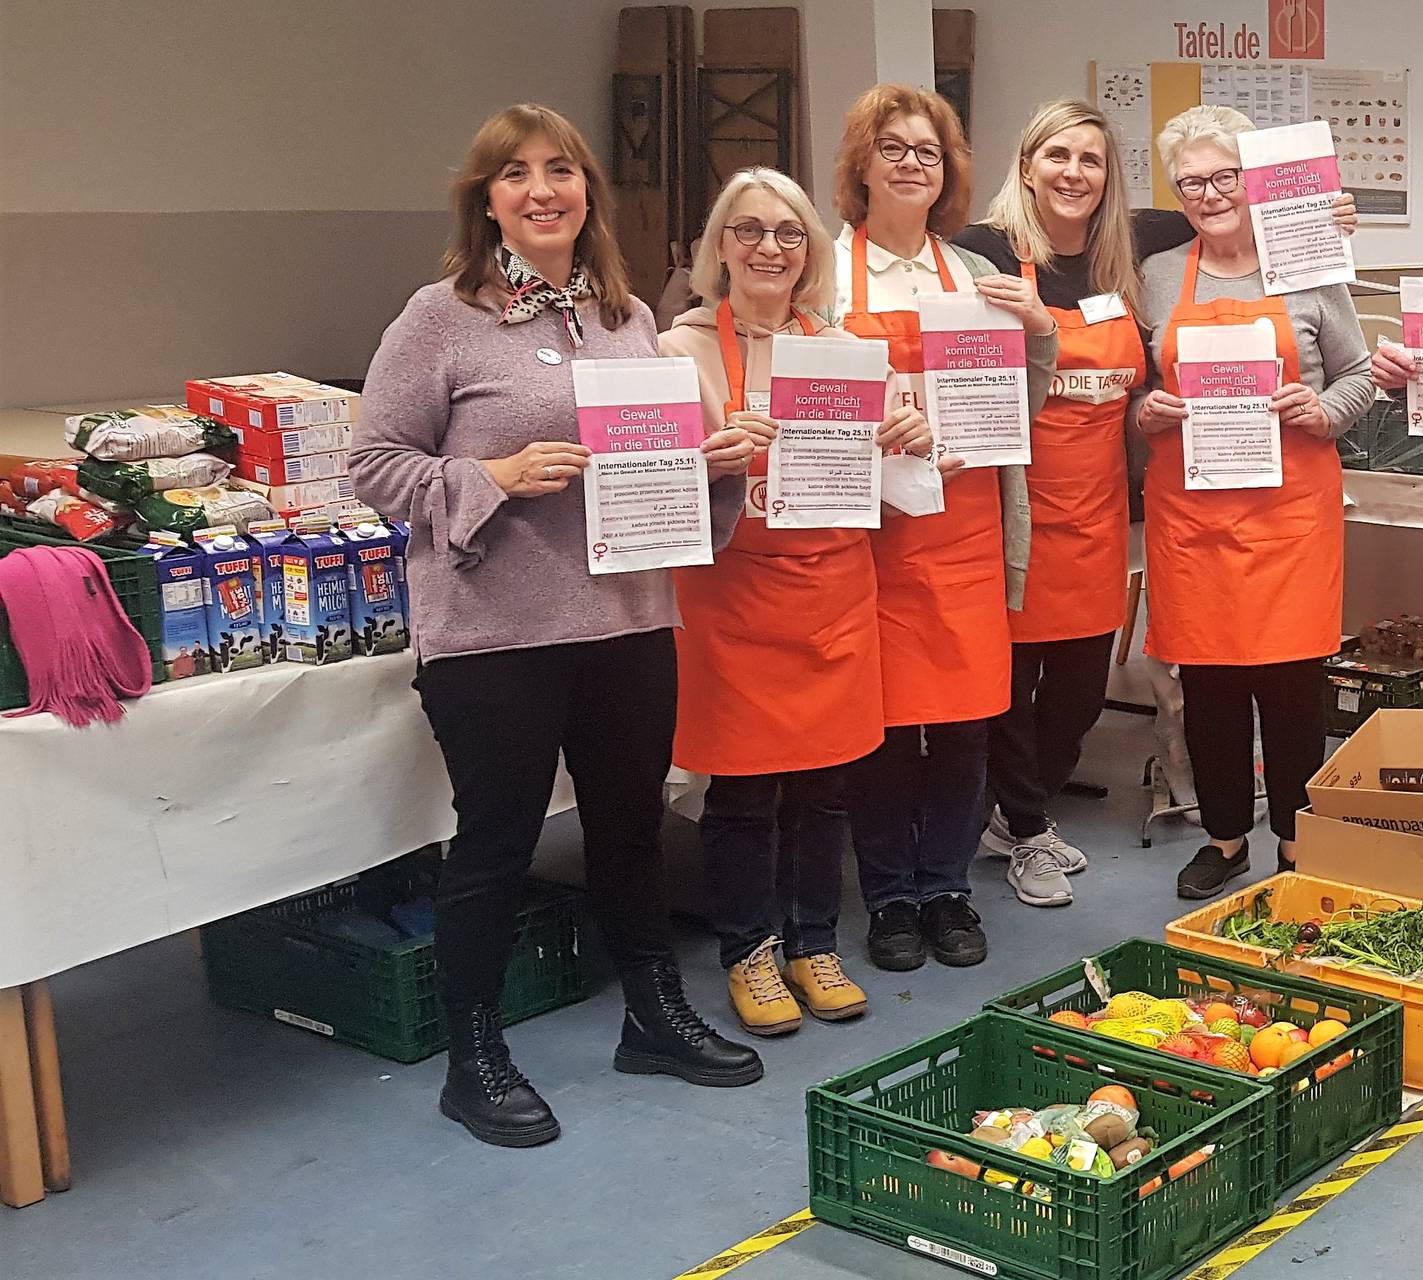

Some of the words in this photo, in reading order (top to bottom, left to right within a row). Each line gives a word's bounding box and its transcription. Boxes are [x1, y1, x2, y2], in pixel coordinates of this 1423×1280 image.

[1173, 22, 1260, 59] Tafel.de
[1275, 163, 1308, 176] Gewalt
[1265, 176, 1297, 189] kommt
[1299, 173, 1320, 184] nicht
[1269, 192, 1278, 200] in
[1279, 190, 1293, 199] die
[1295, 186, 1316, 197] Tüte
[1261, 204, 1305, 215] Internationaler
[1306, 201, 1318, 209] Tag
[957, 334, 990, 344] Gewalt
[945, 346, 977, 356] kommt
[979, 345, 1003, 355] nicht
[947, 359, 956, 368] in
[958, 358, 973, 368] die
[975, 357, 997, 368] Tüte
[1212, 364, 1244, 374] Gewalt
[937, 376, 984, 384] Internationaler
[1069, 375, 1092, 389] DIE
[1200, 376, 1232, 385] kommt
[1235, 375, 1257, 384] nicht
[809, 381, 848, 393] Gewalt
[1202, 388, 1211, 397] in
[1213, 386, 1227, 396] die
[1229, 386, 1251, 396] Tüte
[795, 394, 832, 405] kommt
[834, 395, 861, 407] nicht
[1192, 403, 1238, 411] Internationaler
[1239, 403, 1251, 411] Tag
[620, 408, 662, 421] Gewalt
[796, 408, 805, 418] in
[808, 408, 824, 419] die
[828, 408, 852, 420] Tüte
[606, 423, 648, 436] kommt
[649, 421, 679, 434] nicht
[781, 427, 836, 435] Internationaler
[837, 429, 851, 437] Tag
[610, 440, 622, 452] in
[624, 438, 643, 450] die
[645, 436, 672, 449] Tüte
[598, 460, 657, 470] Internationaler
[659, 459, 673, 467] Tag
[358, 545, 391, 562] TUFFI
[214, 558, 250, 576] TUFFI
[314, 554, 345, 570] TUFFI
[169, 566, 193, 577] TUFFI
[318, 594, 347, 612] MILCH
